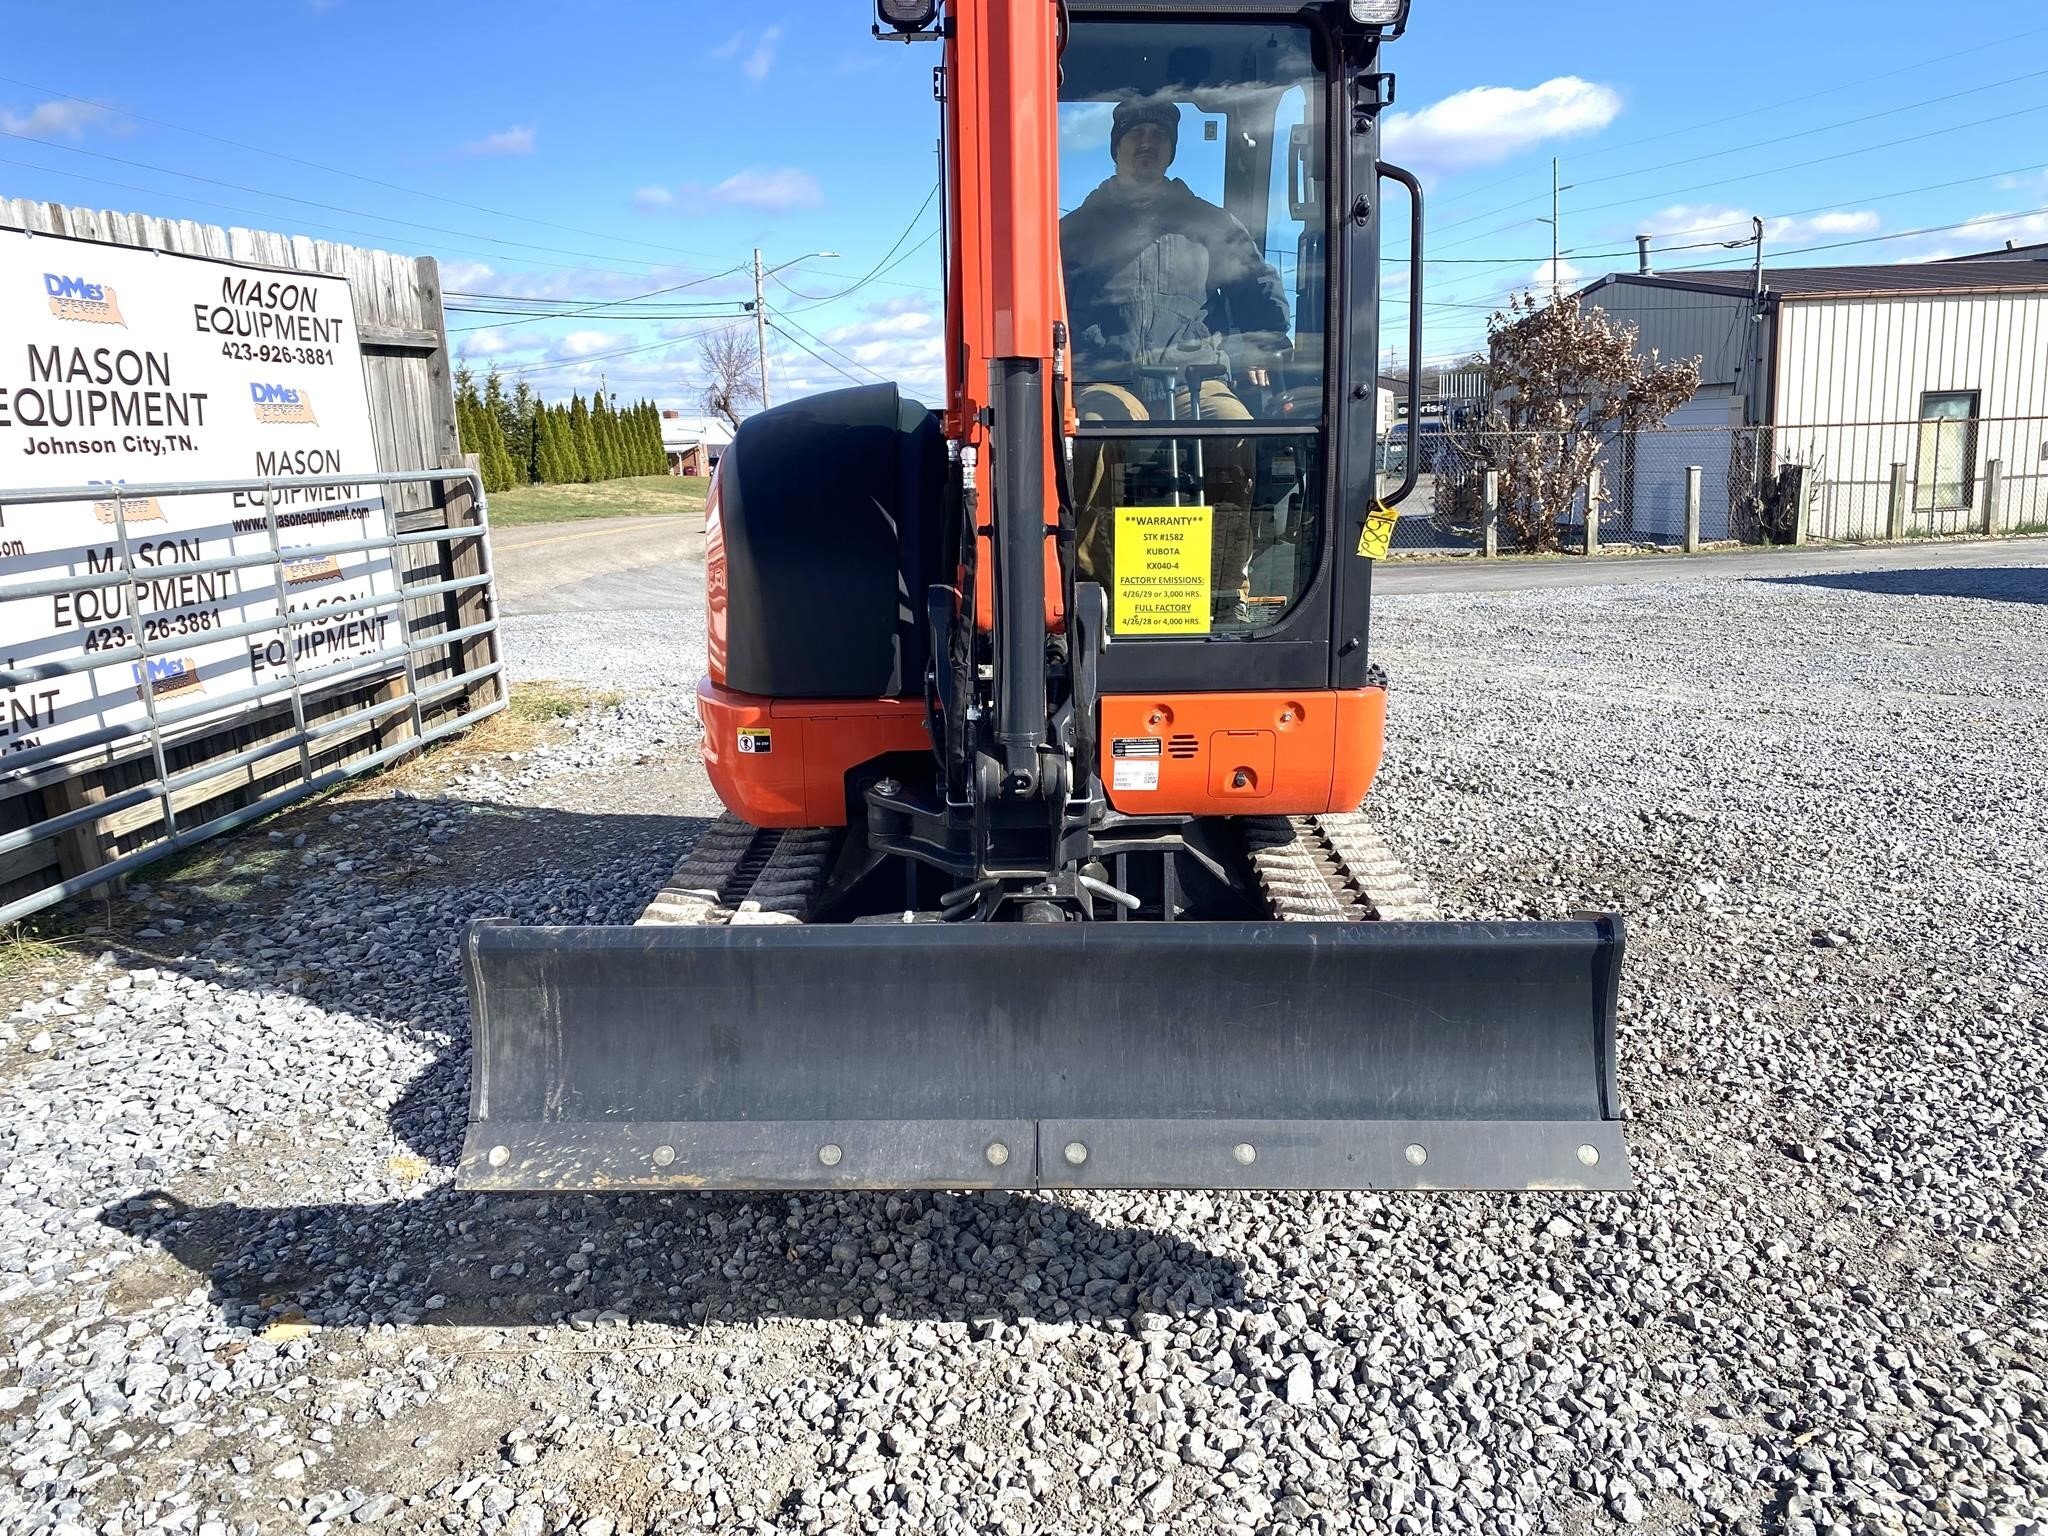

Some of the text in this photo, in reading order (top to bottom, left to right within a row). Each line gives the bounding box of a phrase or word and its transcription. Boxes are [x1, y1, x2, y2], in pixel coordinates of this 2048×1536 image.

[222, 276, 318, 313] MASON
[193, 304, 343, 344] EQUIPMENT
[222, 341, 334, 366] 423-926-3881
[27, 344, 171, 387] MASON
[1397, 403, 1447, 415] erise
[23, 434, 199, 457] Johnson City,TN.
[256, 449, 341, 477] MASON
[1143, 533, 1184, 541] STK #1582
[86, 537, 201, 576] MSON
[1146, 548, 1180, 556] KUBOTA
[1146, 562, 1179, 570] KX040-4
[1120, 576, 1205, 585] FACTORY EMISSIONS:
[1122, 590, 1152, 598] 4/26/29
[1163, 590, 1183, 598] 3,000
[1185, 590, 1202, 598] HRS.
[1135, 604, 1191, 612] FULL FACTORY
[85, 607, 222, 652] 423-26-3881
[1122, 618, 1152, 626] 4/26/28
[1162, 618, 1183, 626] 4,000
[1184, 618, 1201, 626] HRS.
